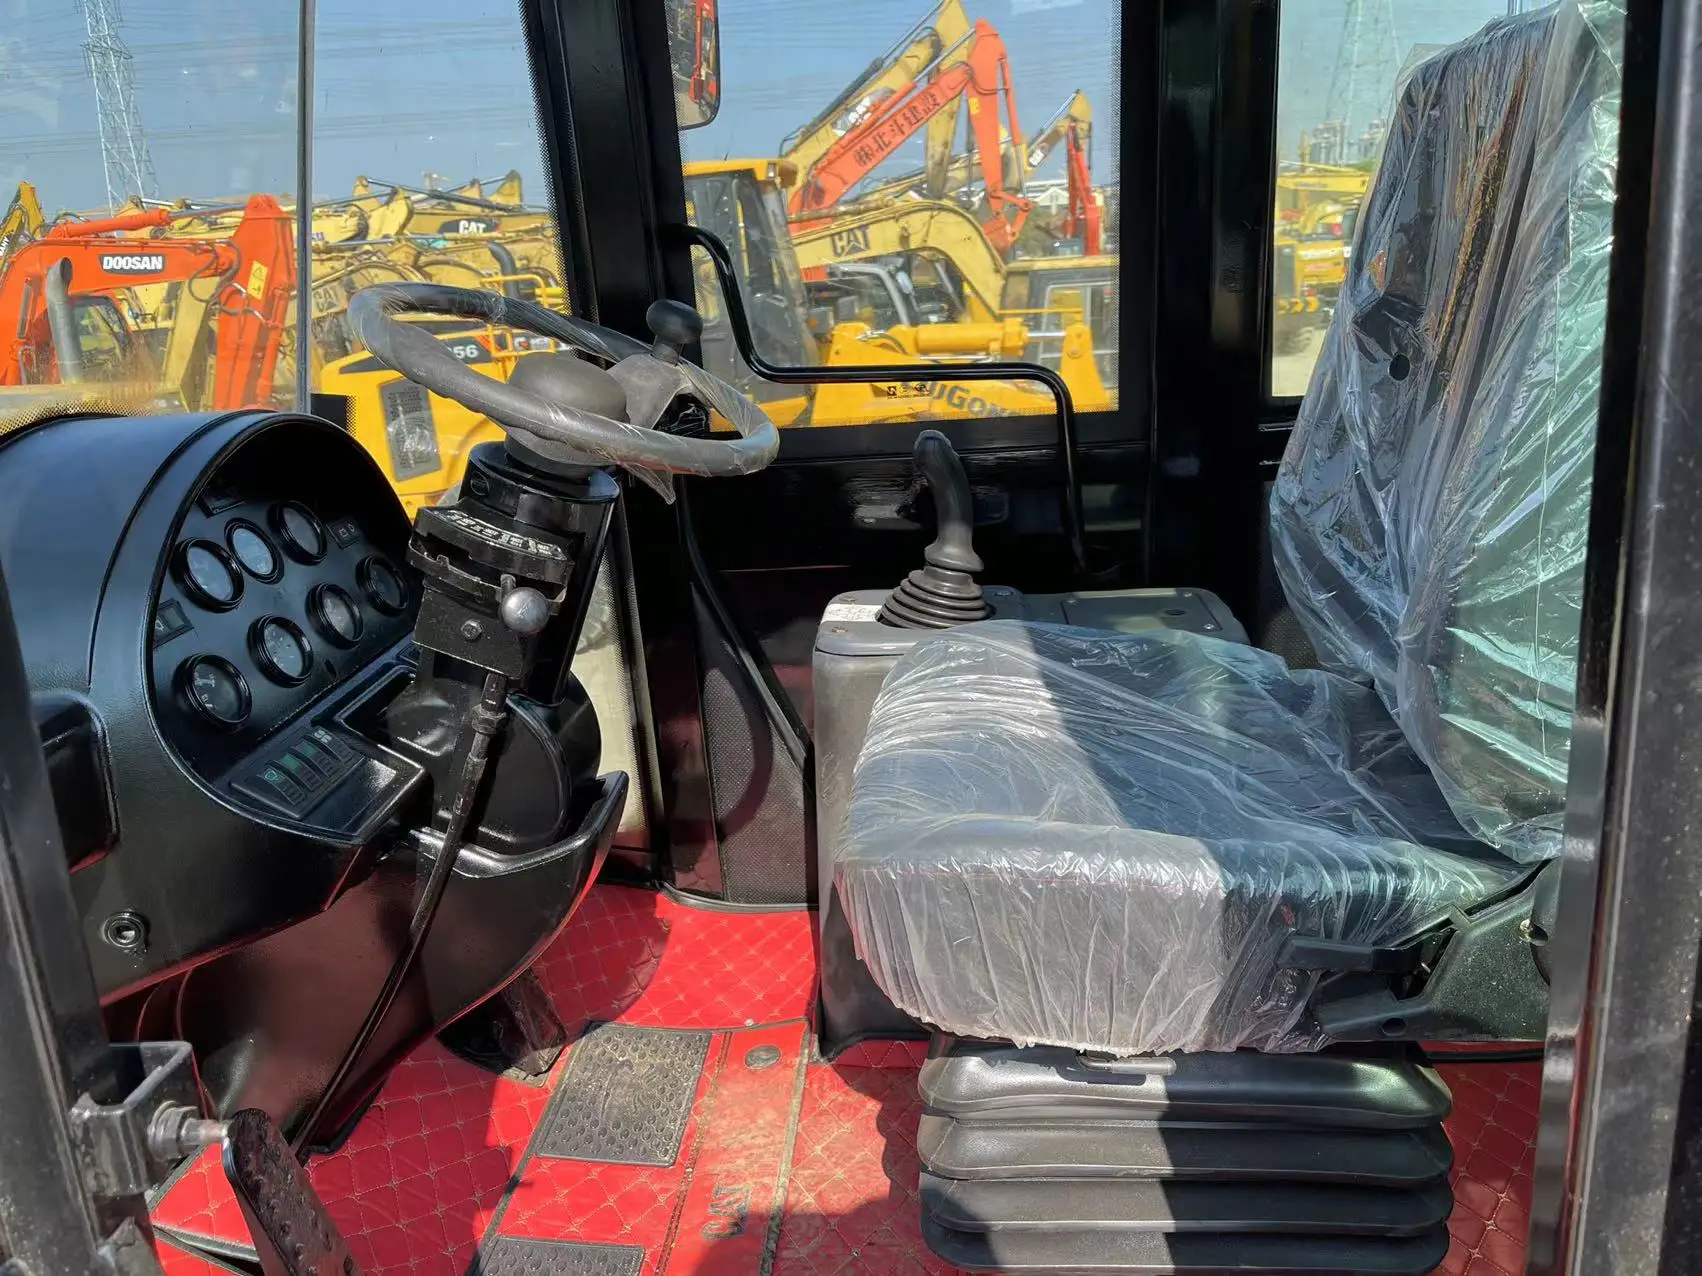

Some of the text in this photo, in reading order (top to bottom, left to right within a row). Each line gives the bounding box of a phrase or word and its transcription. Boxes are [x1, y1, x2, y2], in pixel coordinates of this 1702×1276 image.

[459, 220, 487, 234] CAT
[831, 224, 870, 257] CAT
[103, 256, 163, 270] DOOSAN
[450, 344, 478, 359] 56
[702, 1183, 752, 1239] CAT
